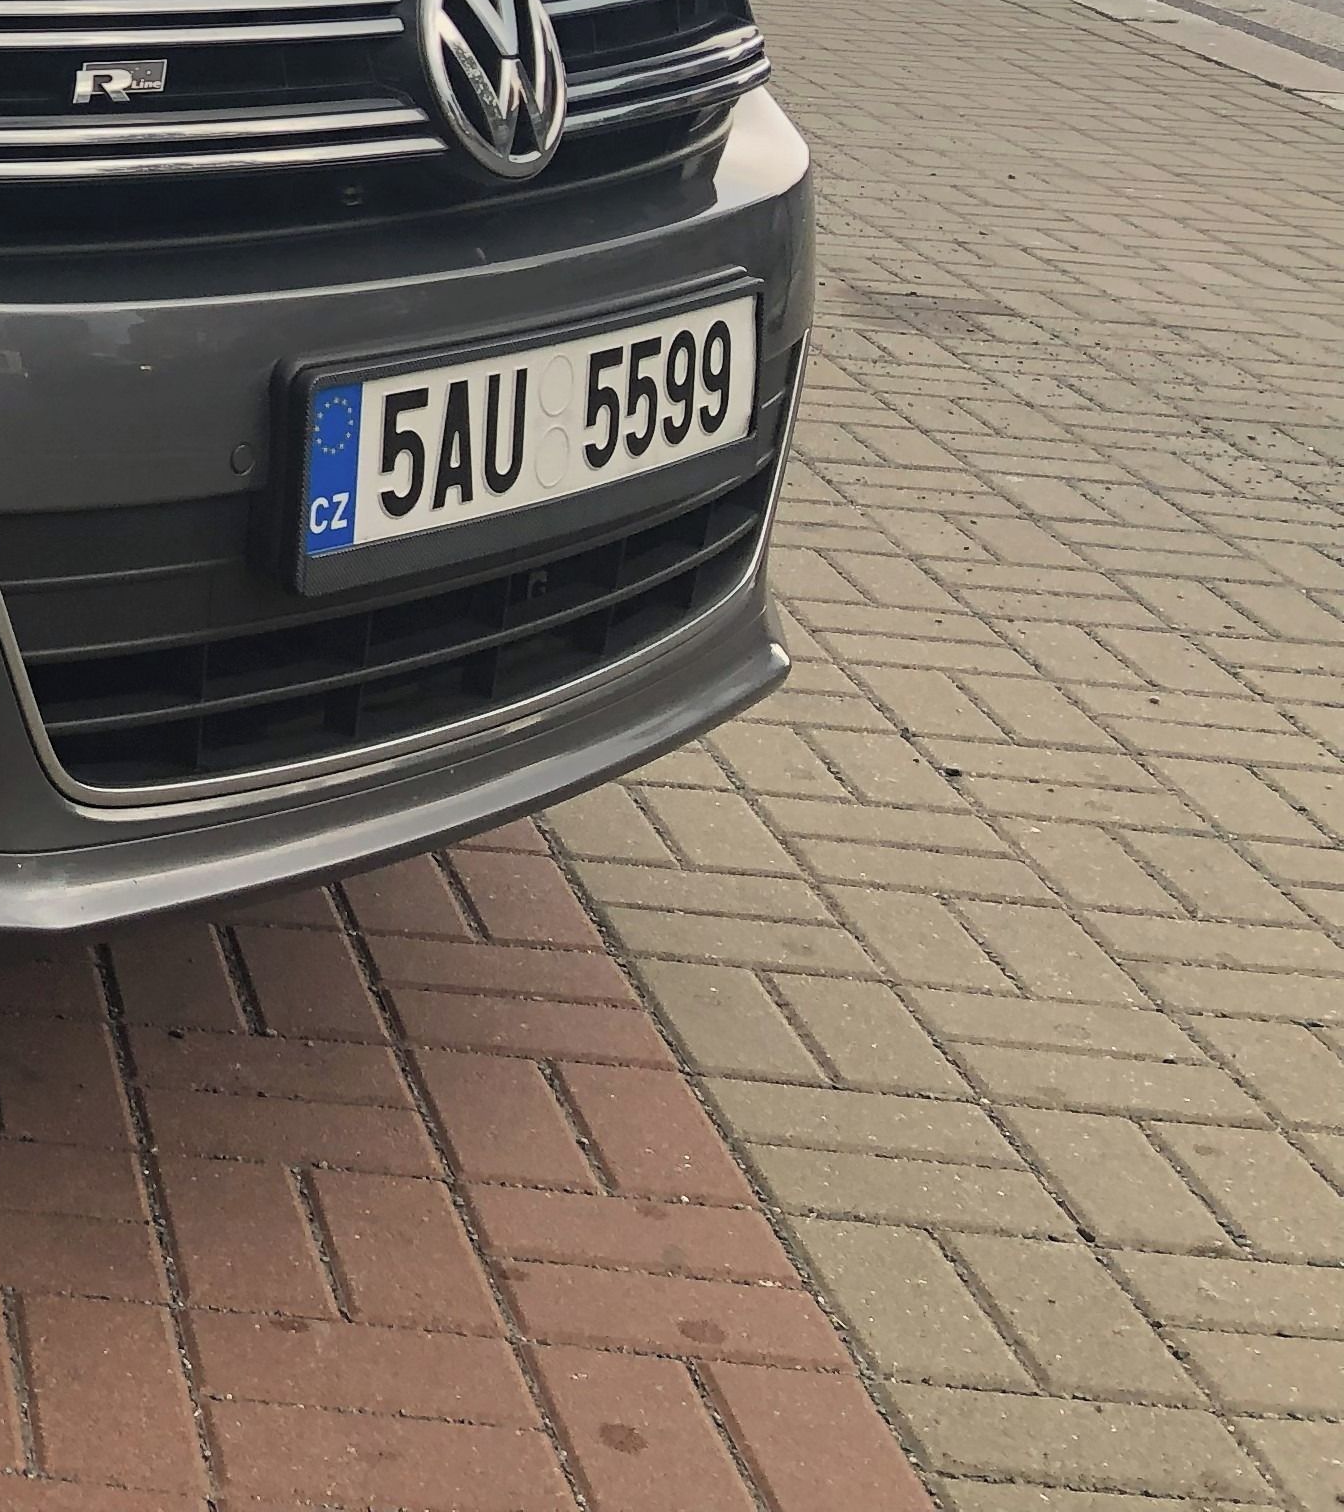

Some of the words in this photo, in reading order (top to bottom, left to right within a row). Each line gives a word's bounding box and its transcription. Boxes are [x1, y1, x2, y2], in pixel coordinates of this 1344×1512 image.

[379, 367, 529, 518] 5AU
[585, 319, 732, 470] 5599
[309, 491, 350, 535] CZ
